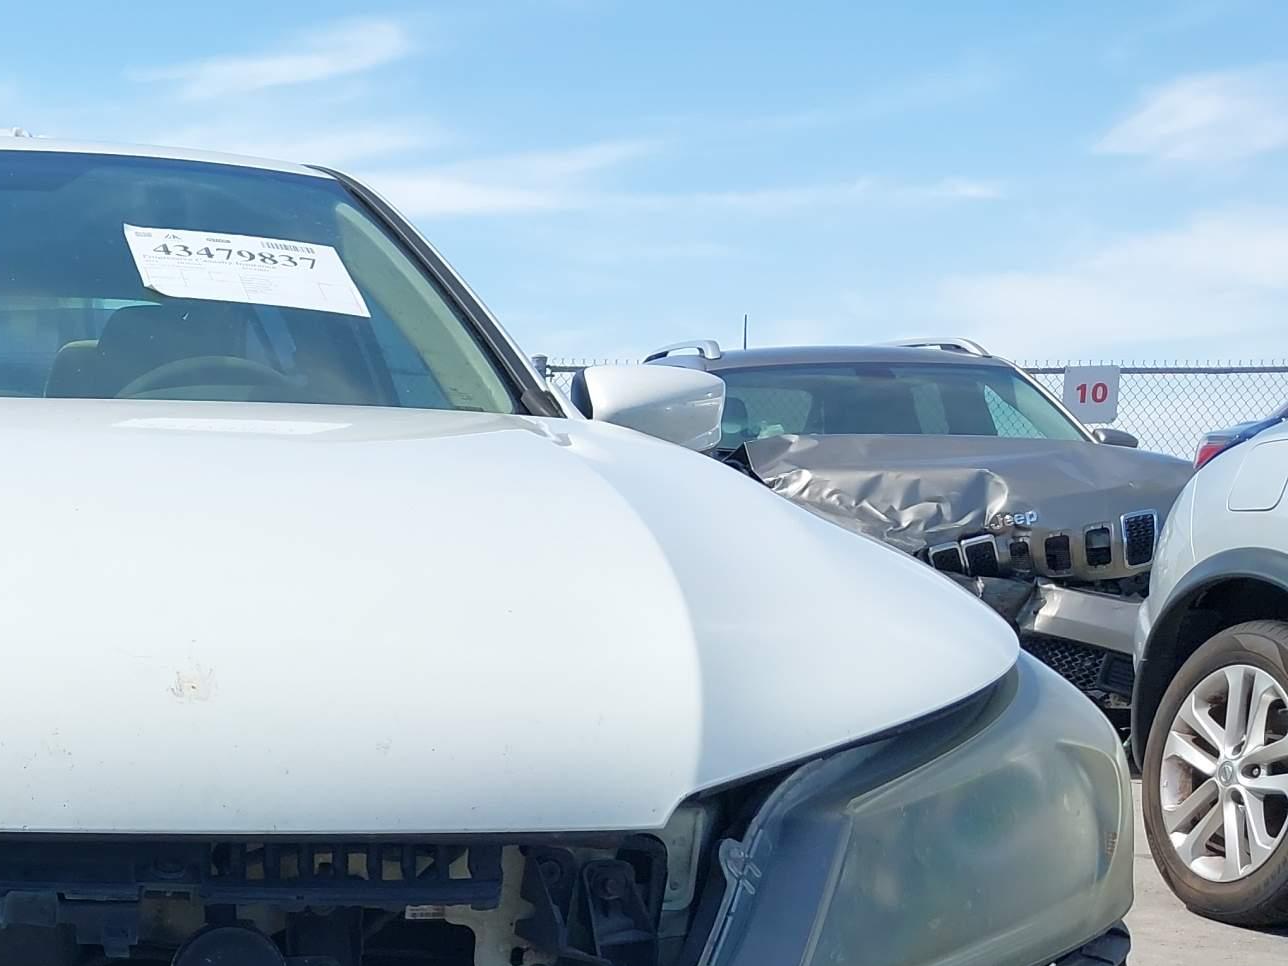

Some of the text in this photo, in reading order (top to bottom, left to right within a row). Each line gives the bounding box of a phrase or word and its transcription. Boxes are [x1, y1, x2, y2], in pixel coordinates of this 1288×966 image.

[152, 243, 316, 269] 43479837
[1076, 383, 1108, 403] 10
[990, 511, 1038, 529] Jeep
